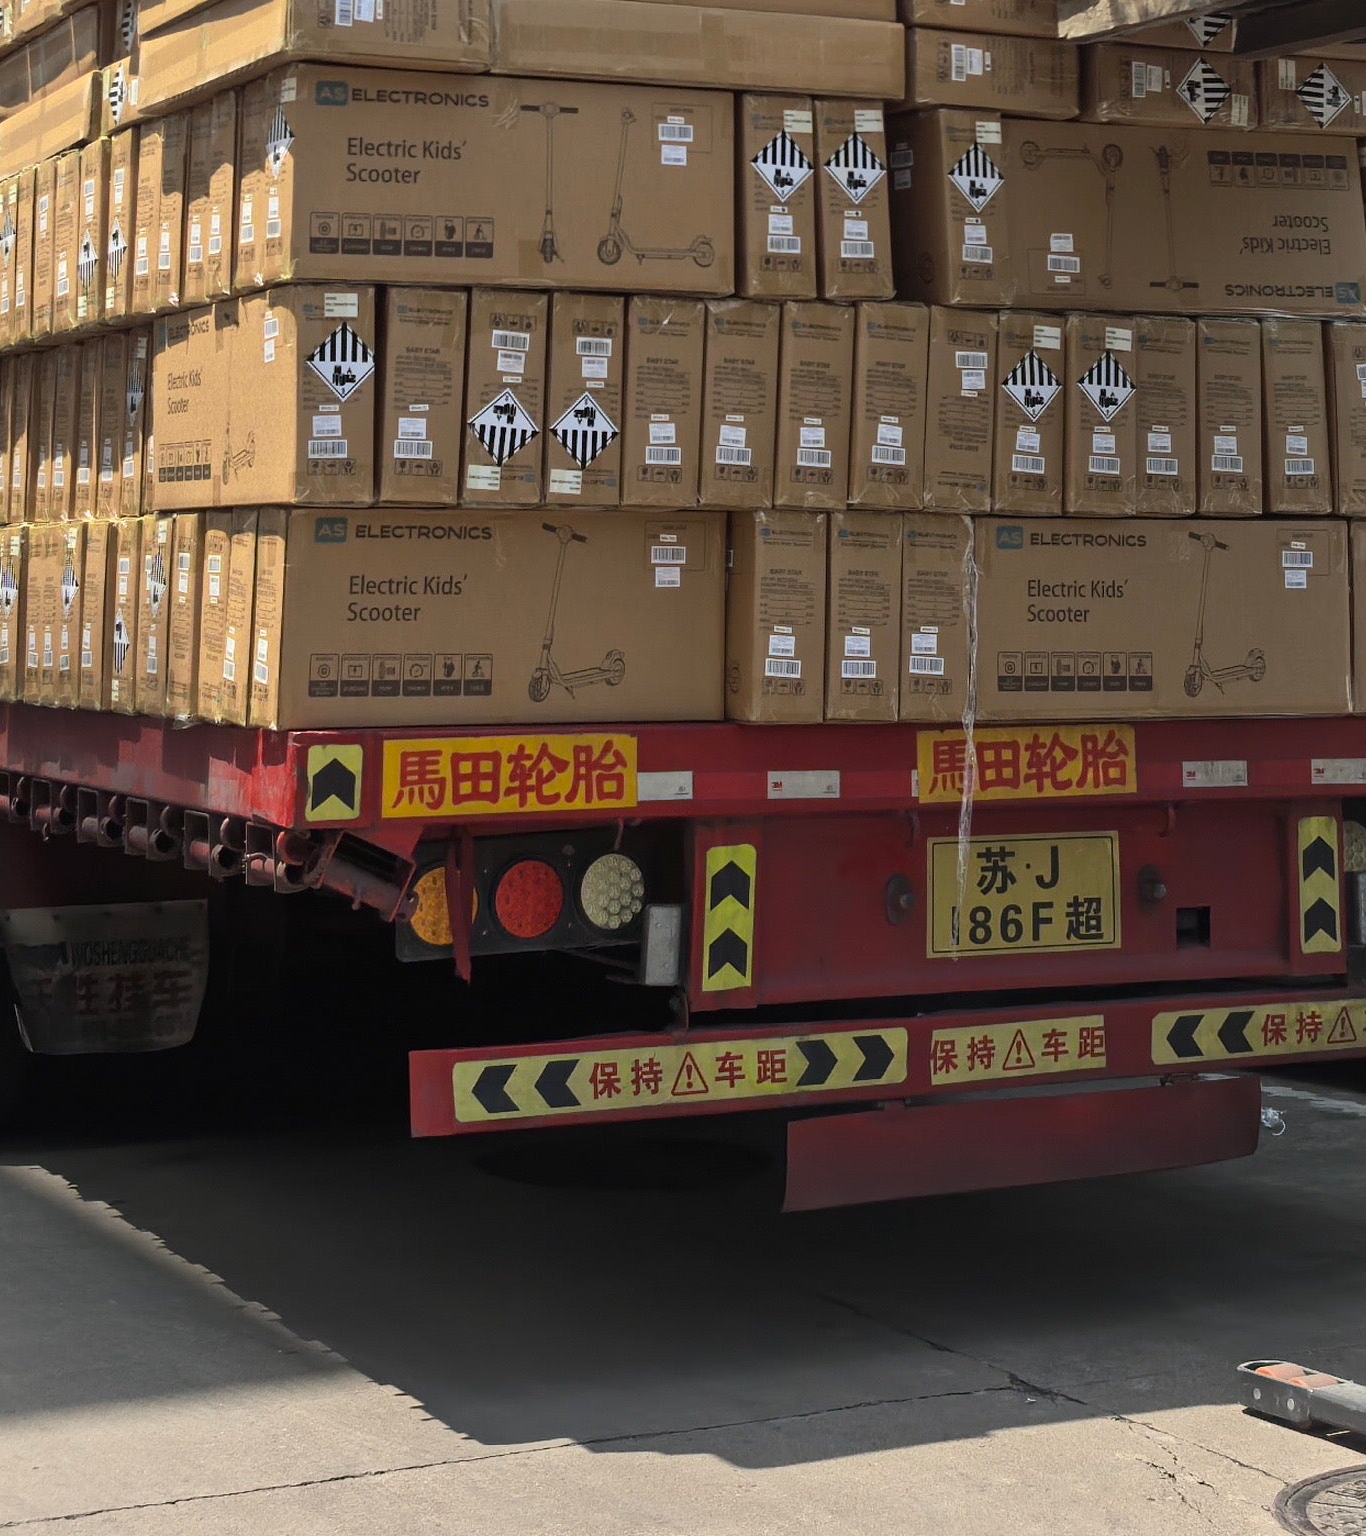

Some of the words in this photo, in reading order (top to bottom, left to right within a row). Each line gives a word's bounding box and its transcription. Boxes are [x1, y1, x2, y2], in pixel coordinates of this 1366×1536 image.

[351, 87, 490, 108] ELECTRONICS
[346, 137, 418, 159] Electric
[422, 140, 467, 161] Kids'
[346, 164, 421, 184] Scooter
[1271, 214, 1330, 231] Scooter
[1276, 237, 1332, 255] Electric
[1225, 283, 1335, 298] ELECTRONICS
[355, 524, 492, 541] ELECTRONICS
[1030, 531, 1147, 548] ELECTRONICS
[348, 575, 419, 596] Electric
[423, 573, 468, 596] Kids'
[1027, 579, 1088, 599] Electric
[1090, 578, 1129, 599] Kids'
[347, 602, 421, 623] Scooter
[1027, 605, 1090, 624] Scooter
[928, 730, 1130, 796] 馬田轮胎
[392, 741, 628, 810] 馬田轮胎
[1261, 1011, 1323, 1046] 保持
[930, 1036, 996, 1074] 保持
[1041, 1026, 1106, 1062] 车距
[589, 1057, 664, 1100] 保持
[714, 1049, 789, 1089] 车距
